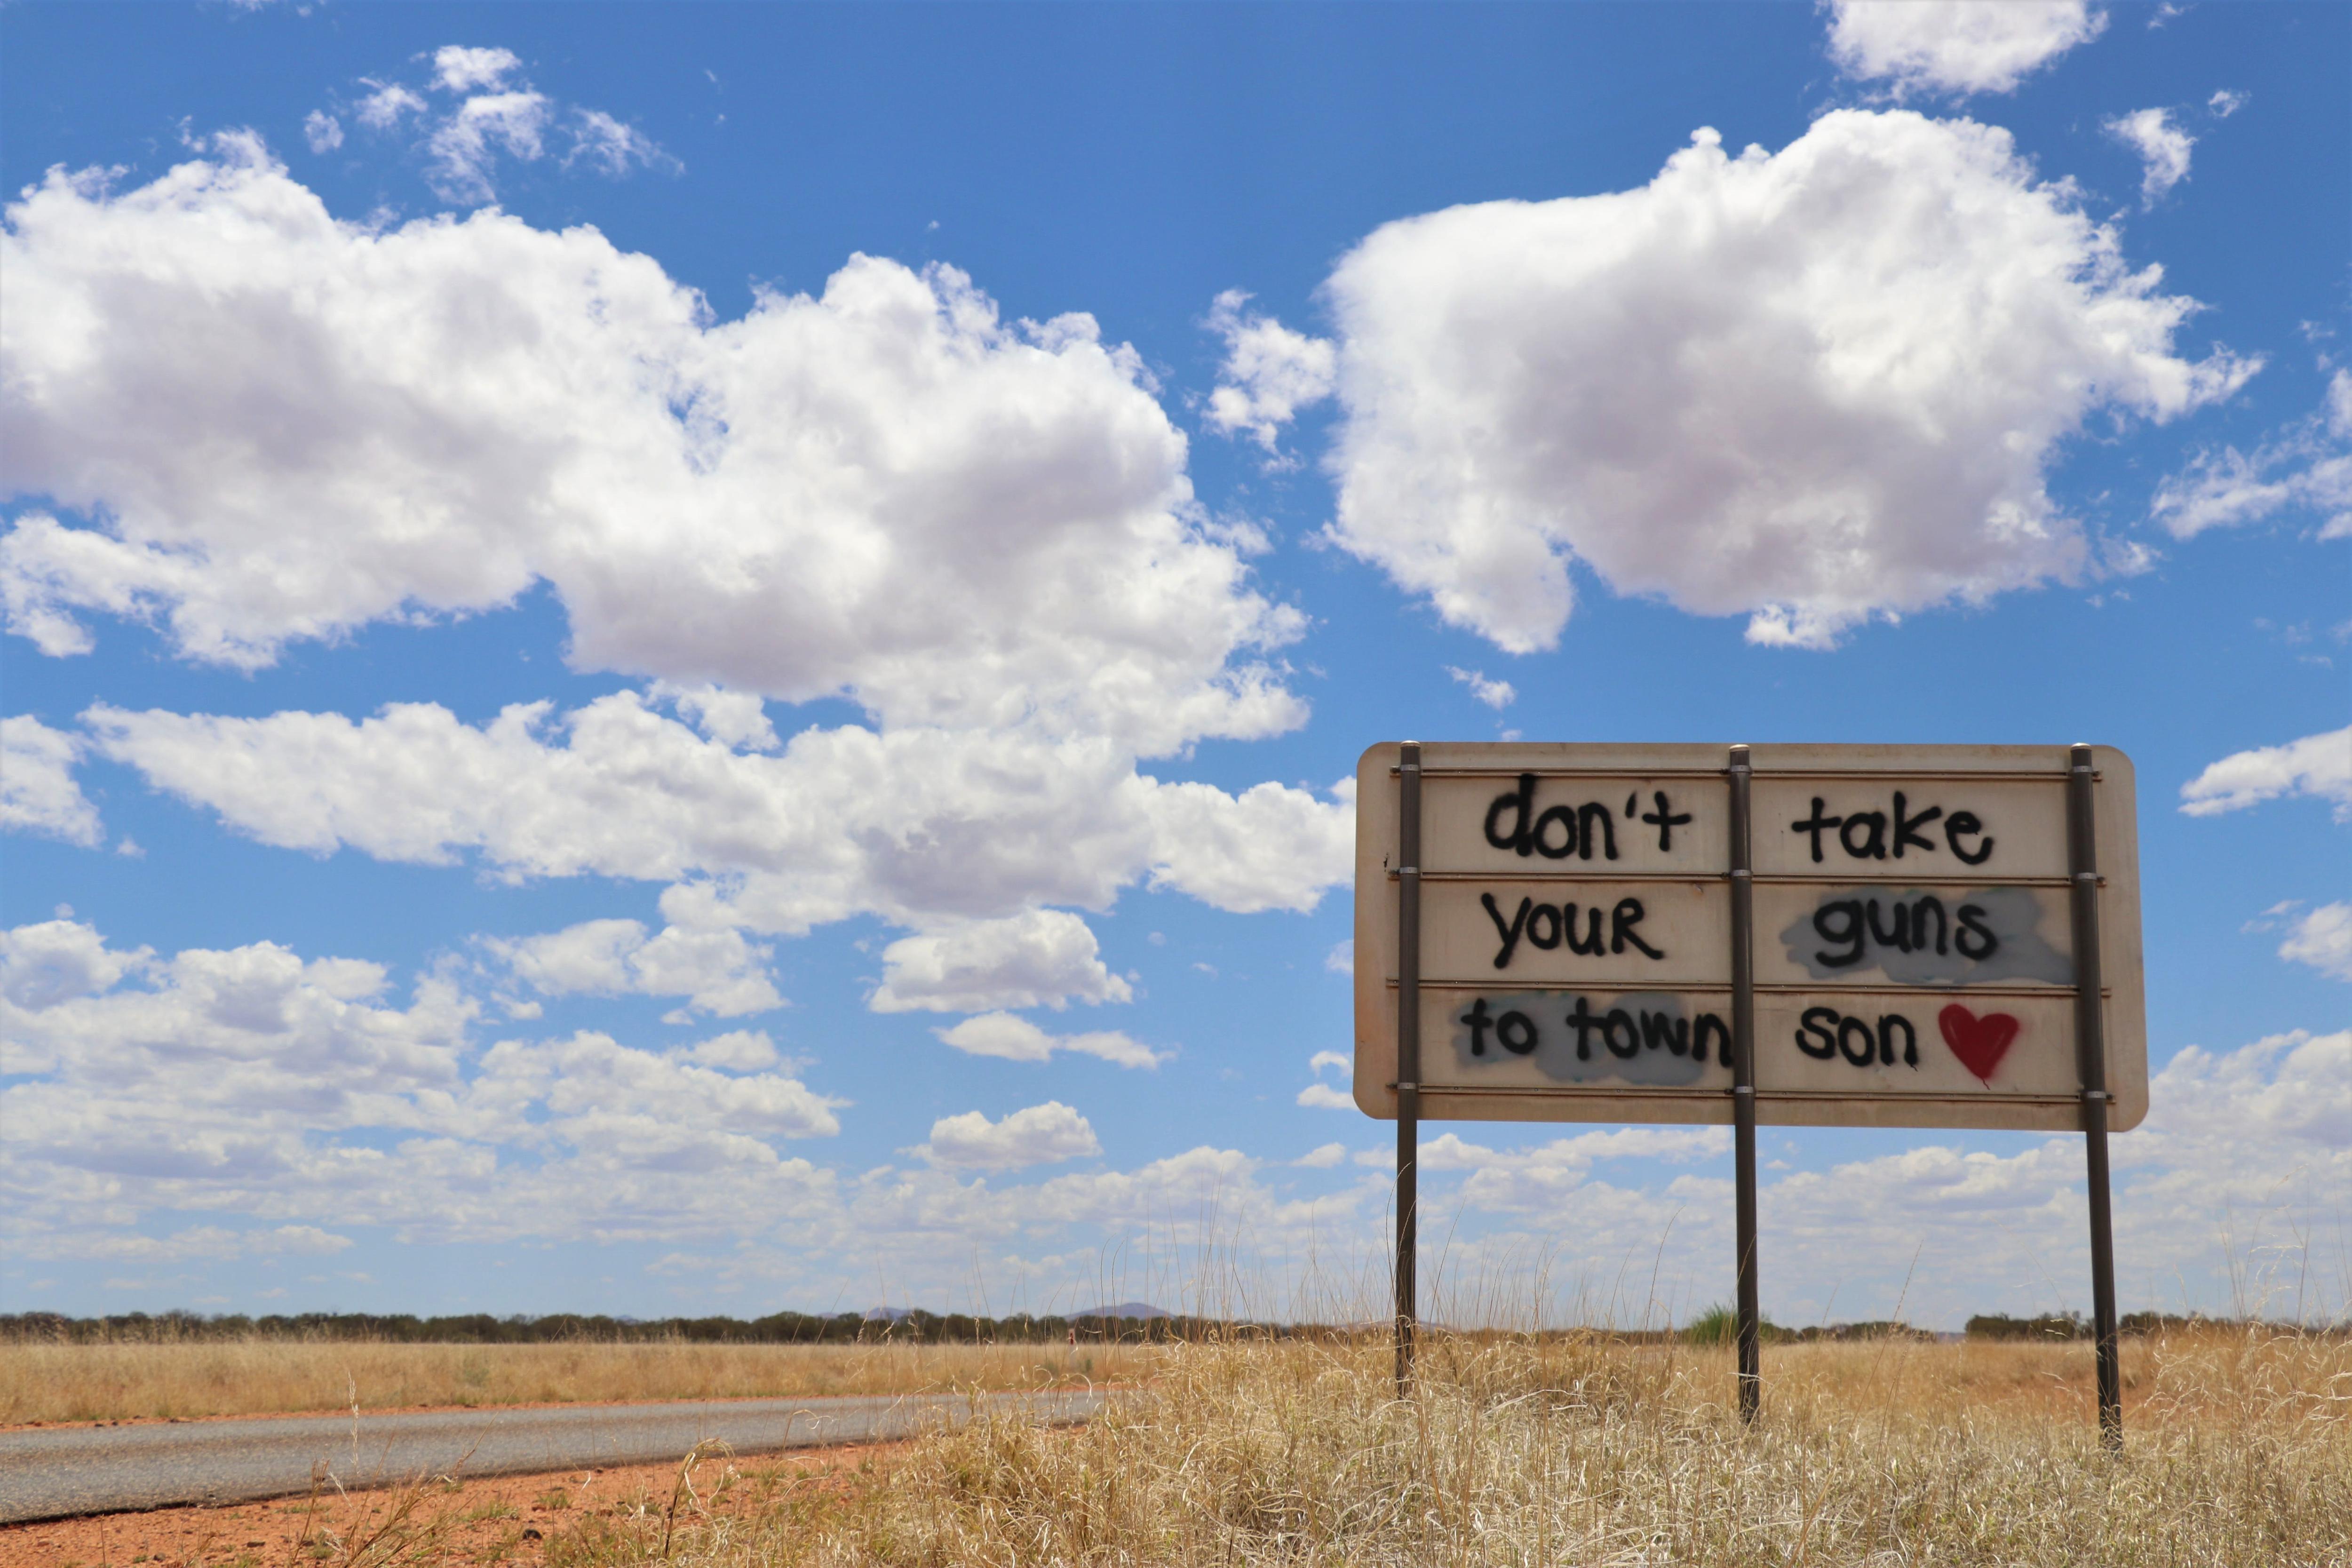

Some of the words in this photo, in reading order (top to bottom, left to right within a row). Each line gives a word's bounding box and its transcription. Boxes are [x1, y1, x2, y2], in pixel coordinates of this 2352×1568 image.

[1484, 773, 1692, 860] don't
[1791, 791, 1994, 865] take
[1812, 895, 2001, 970] guns
[1460, 997, 1540, 1057] to
[1565, 996, 1733, 1070] town
[1795, 1007, 1919, 1068] son
